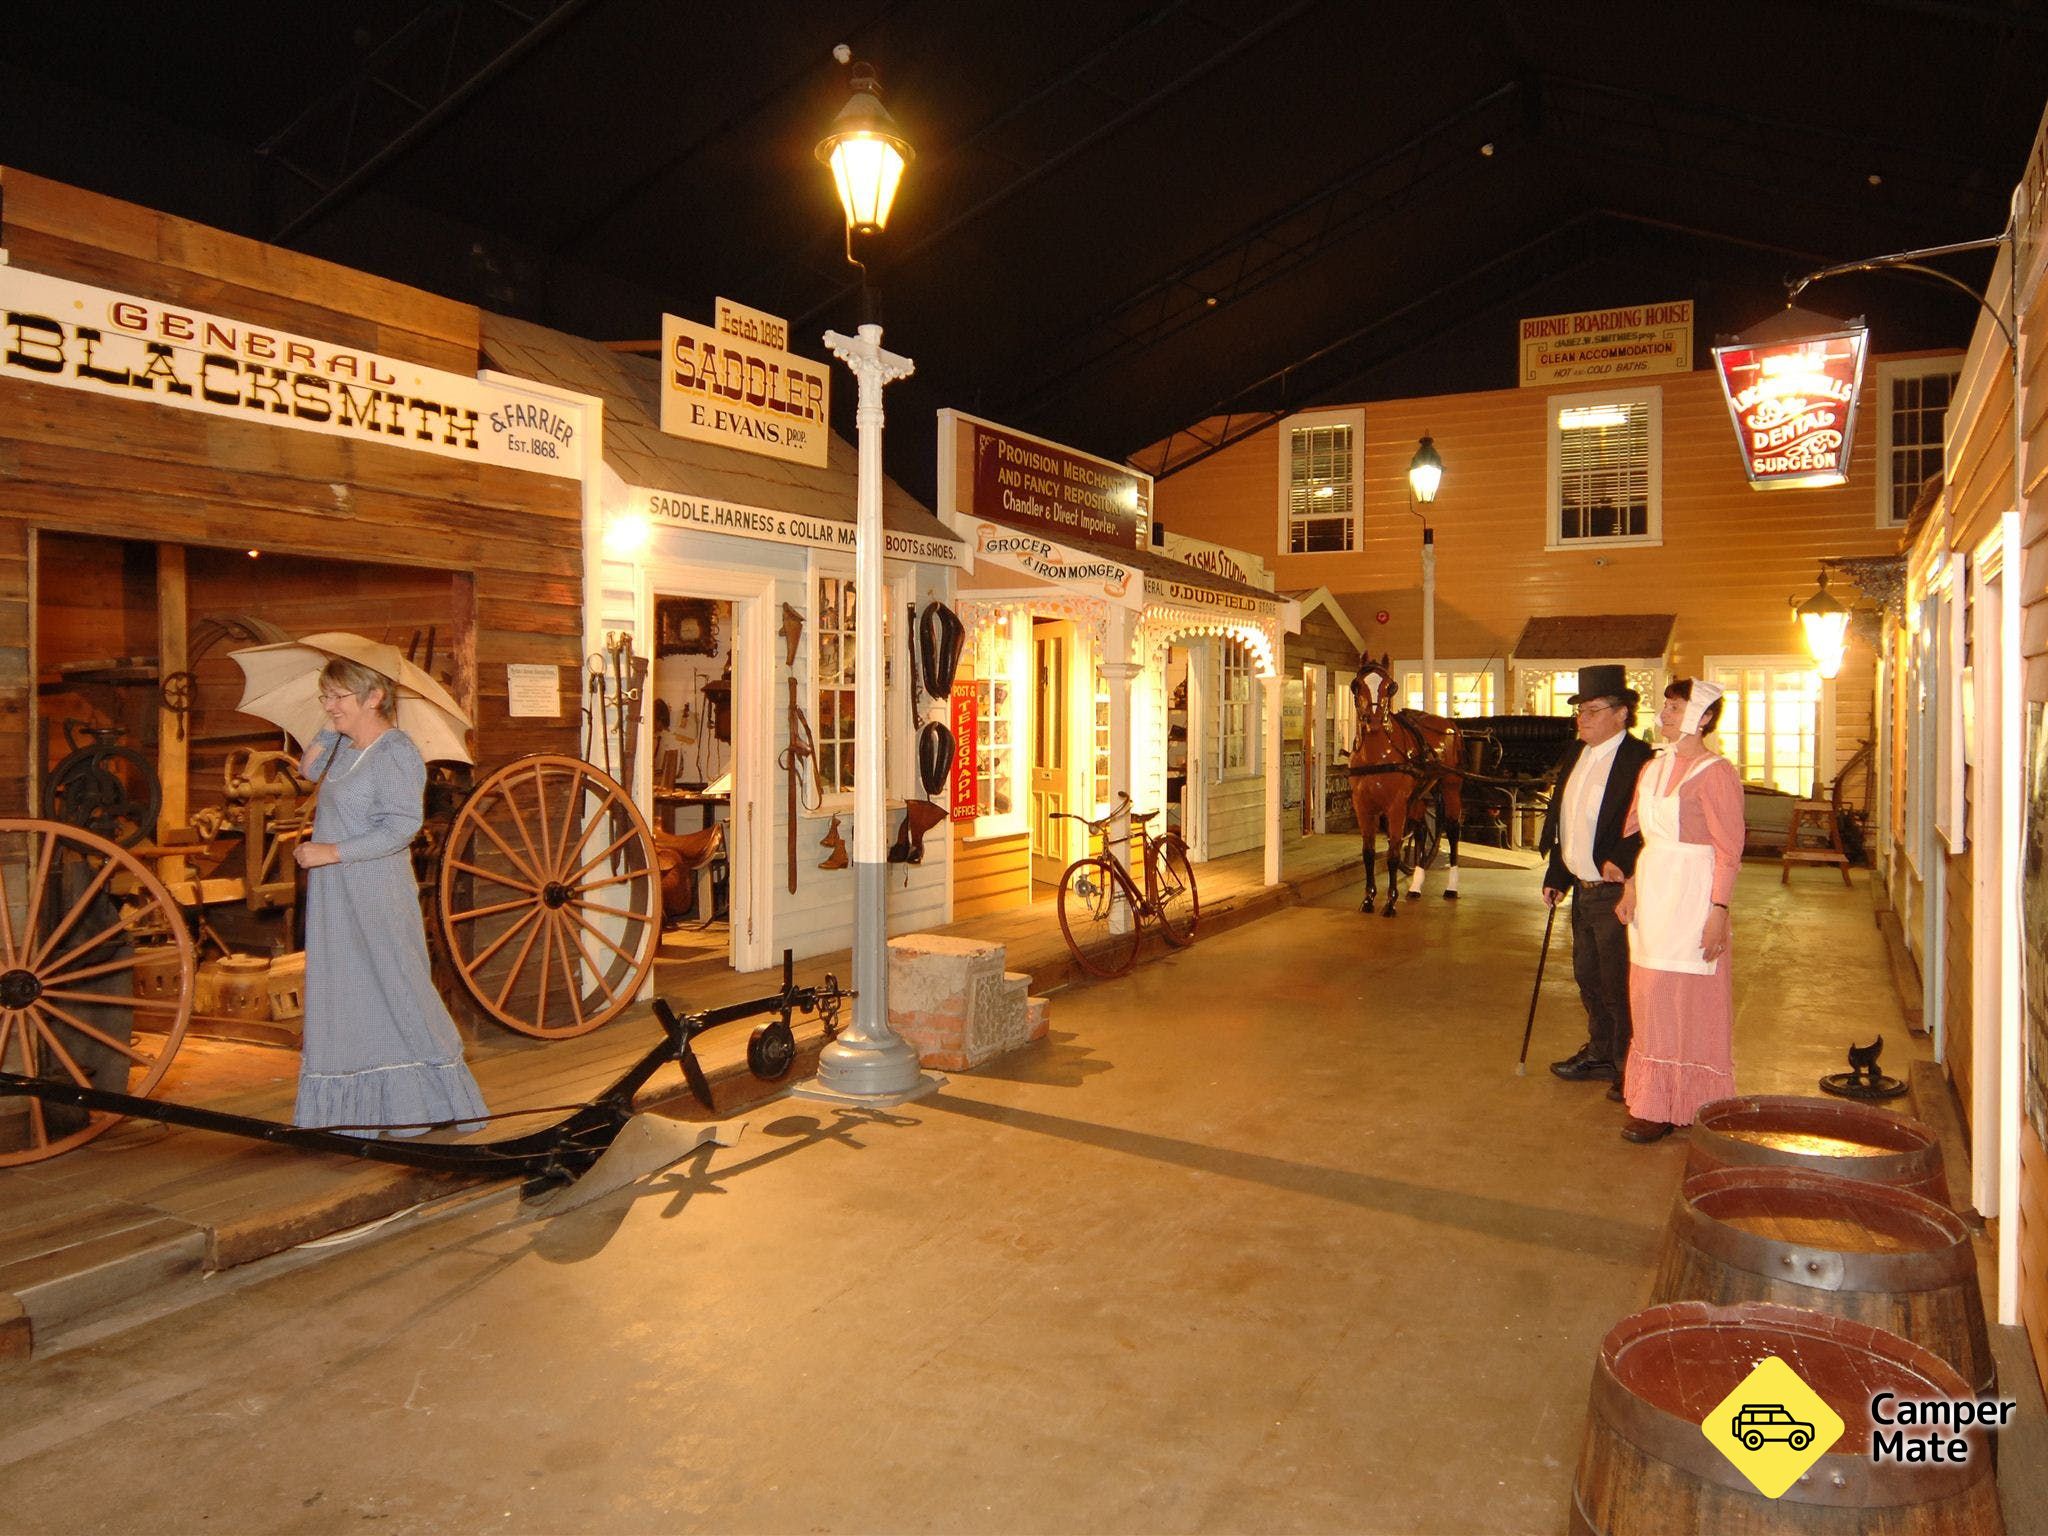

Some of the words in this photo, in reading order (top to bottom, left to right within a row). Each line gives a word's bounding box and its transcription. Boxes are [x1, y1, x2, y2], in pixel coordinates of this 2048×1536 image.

[1523, 318, 1570, 339] BURNIE
[1574, 309, 1642, 332] BOARDING
[1645, 304, 1690, 324] HOUSE
[111, 301, 396, 386] GENERAL
[1540, 352, 1576, 365] CLEAN
[1578, 343, 1673, 362] ACCOMMODATION
[6, 311, 480, 450] BLACKSMITH
[672, 334, 825, 424] SADDLER
[1553, 367, 1573, 378] HOT
[1586, 364, 1613, 376] COLD
[1615, 360, 1649, 373] BATHS
[690, 403, 712, 428] E.
[716, 410, 784, 444] EVANS.
[1752, 410, 1836, 450] DENTAL
[998, 439, 1060, 476] PROVISION
[1753, 452, 1836, 474] SURGEON
[998, 467, 1022, 488] AND
[1024, 473, 1061, 499] FANCY
[1003, 489, 1044, 514] Chandler
[1053, 502, 1079, 528] Direct
[777, 522, 786, 535] &
[790, 519, 834, 542] COLLAR
[838, 527, 857, 546] MA
[885, 535, 919, 554] BOOTS
[985, 538, 1052, 558] GROCER
[1144, 579, 1164, 597] NERAL
[953, 685, 970, 698] POST
[970, 685, 976, 697] &
[958, 699, 972, 804] TELEGRAPH
[953, 805, 976, 818] OFFICE
